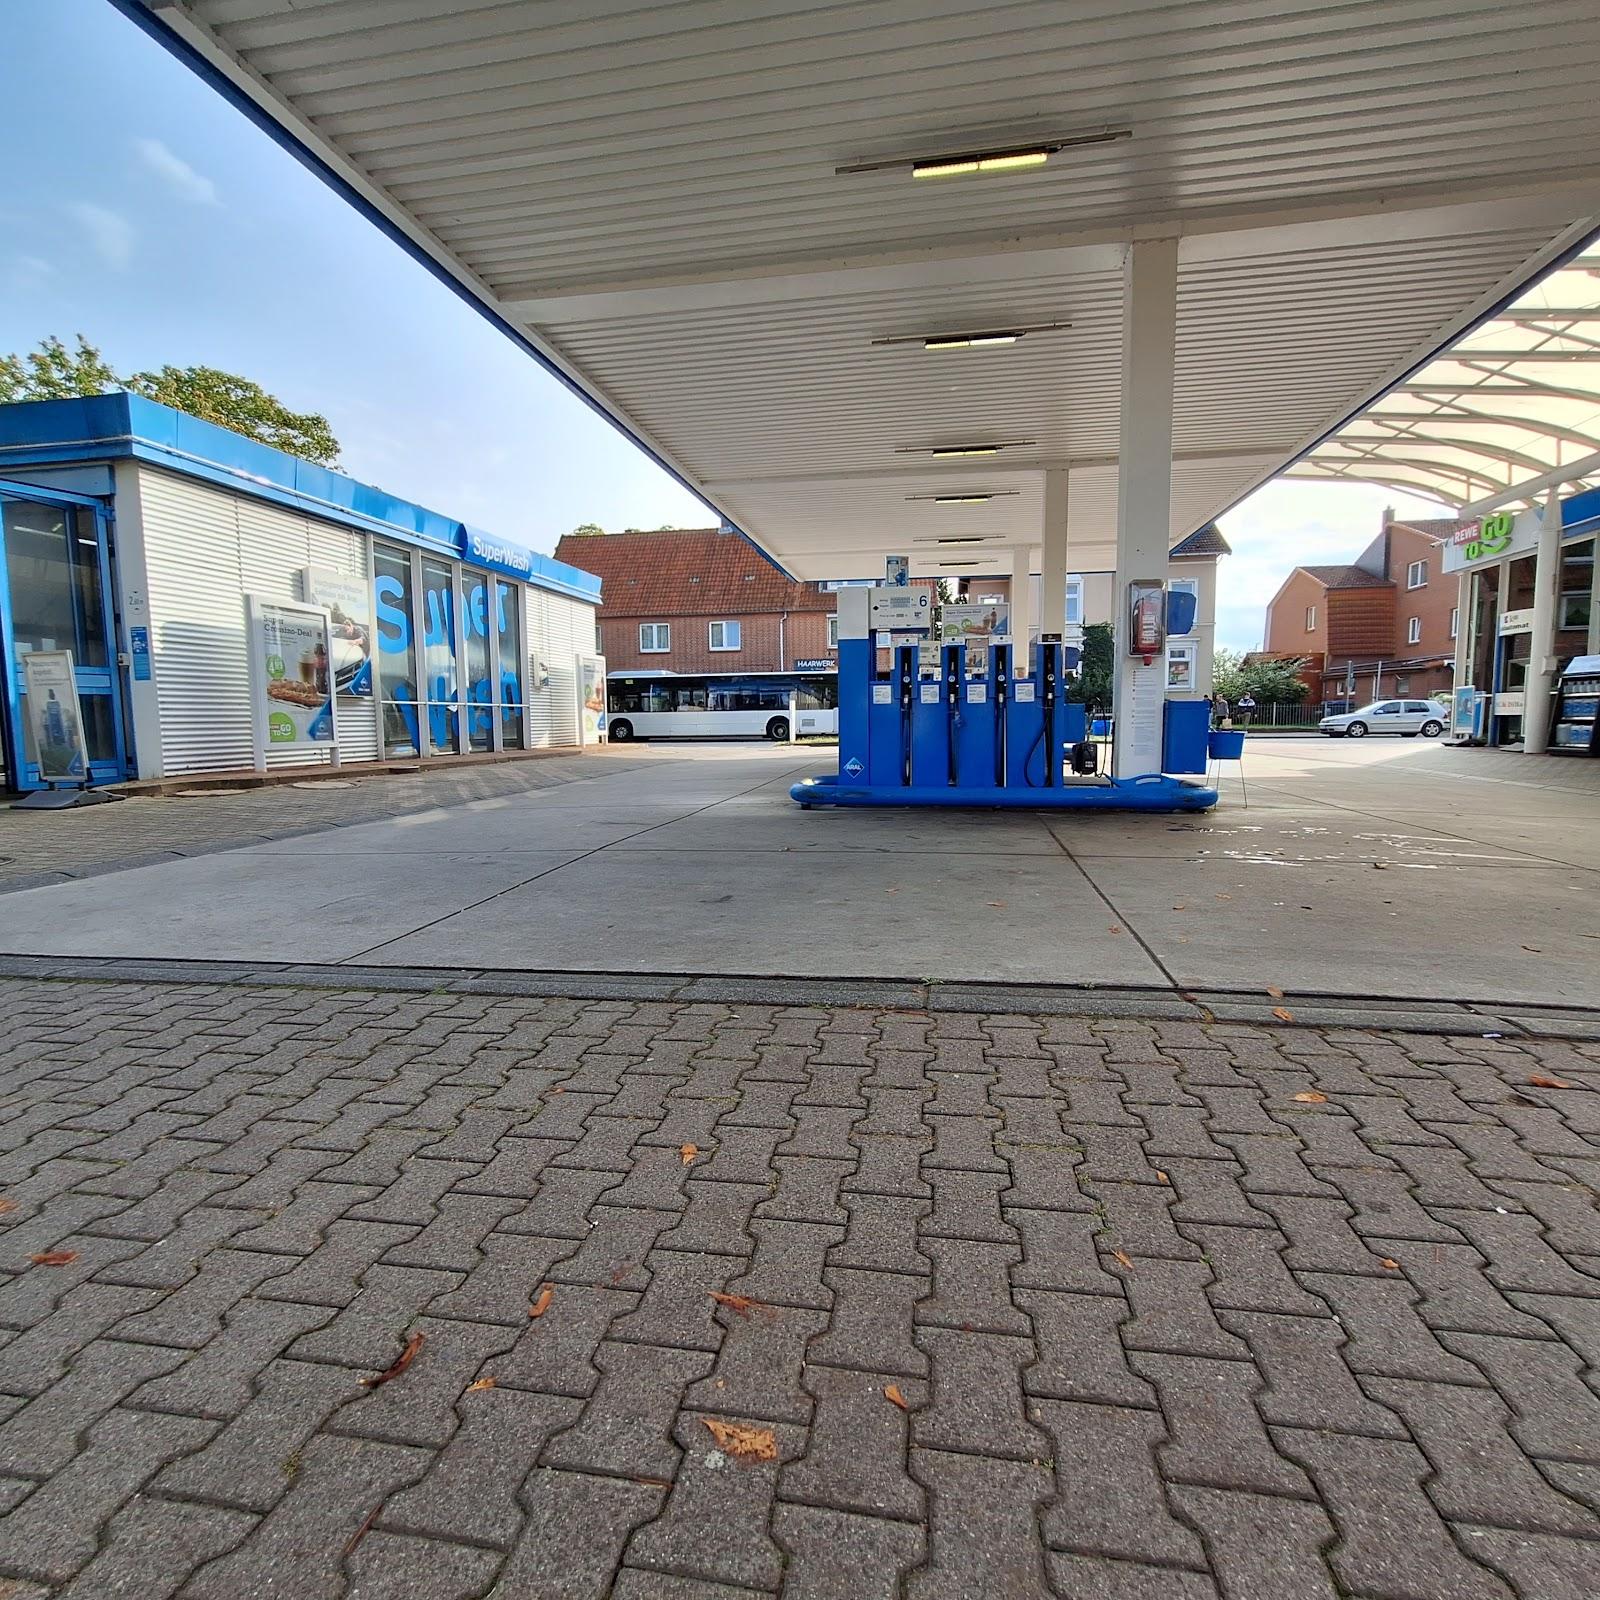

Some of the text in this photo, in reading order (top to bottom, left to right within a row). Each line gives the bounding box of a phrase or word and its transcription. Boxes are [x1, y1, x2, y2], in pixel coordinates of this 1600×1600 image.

[1454, 511, 1512, 543] REWE GO
[473, 535, 529, 572] SuperWash
[374, 575, 508, 657] Super
[919, 595, 928, 607] 6
[797, 660, 836, 668] HAARWERK
